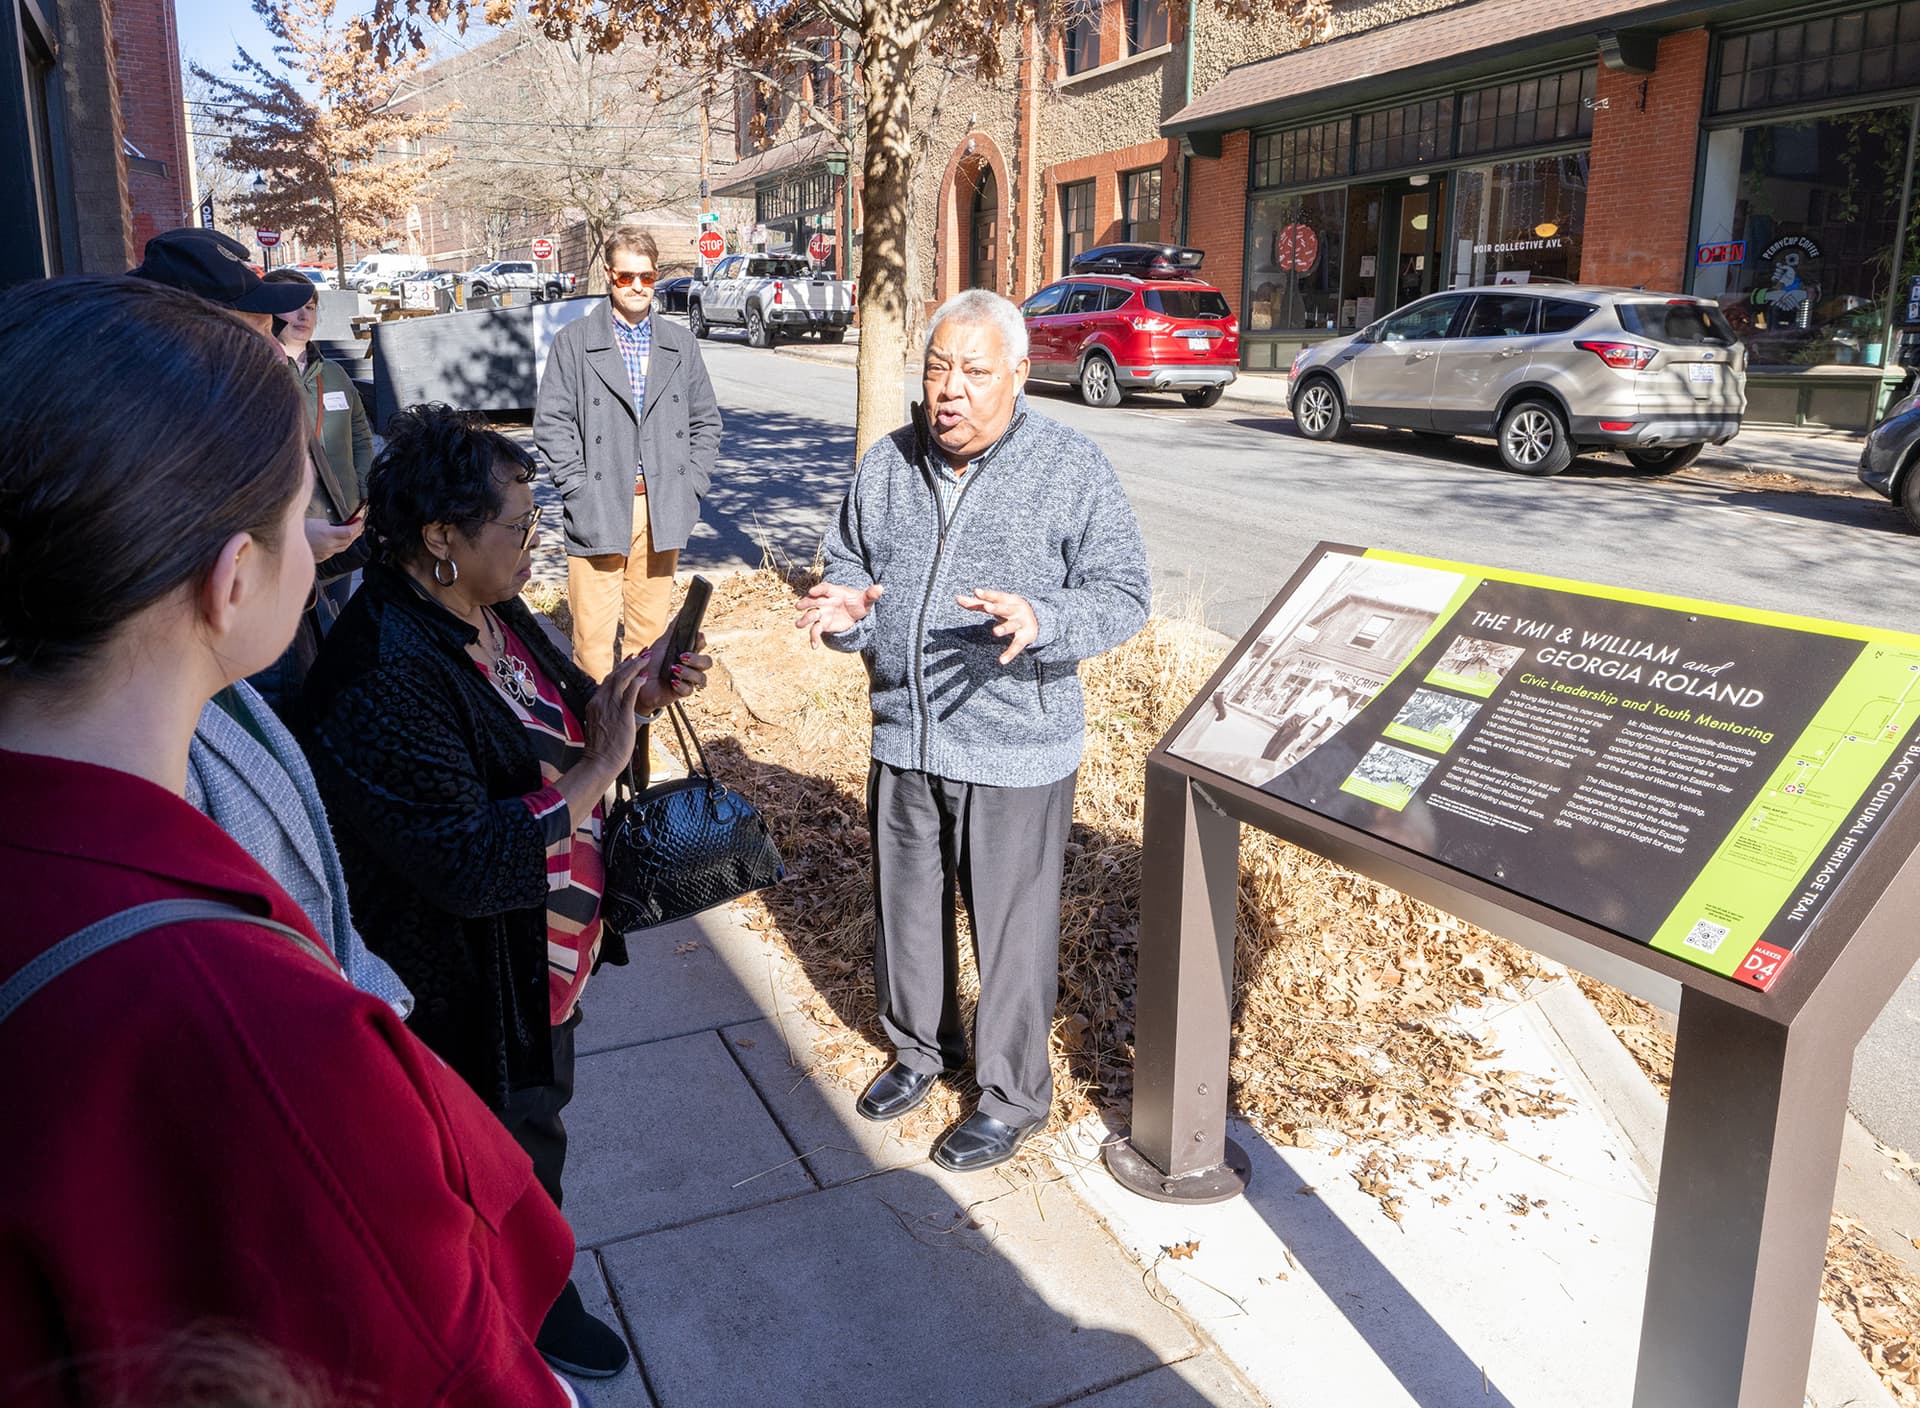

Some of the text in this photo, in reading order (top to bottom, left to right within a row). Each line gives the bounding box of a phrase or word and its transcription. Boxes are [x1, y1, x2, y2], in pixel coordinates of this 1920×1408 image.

[202, 205, 214, 230] OPE
[700, 239, 723, 251] STOP
[1473, 238, 1562, 254] NOIR COLLECTIVE AVL
[1697, 244, 1745, 264] OPEN
[1472, 610, 1735, 677] THE YMI & WILLIAM and
[1536, 647, 1764, 707] GEORGIA ROLAND
[1520, 673, 1774, 744] Civic Leadership and Youth Mentoring
[1621, 728, 1753, 767] County Citizens Organization, protecting
[1638, 722, 1663, 733] Roland
[1662, 728, 1674, 736] led
[1673, 731, 1685, 739] the
[1685, 734, 1757, 756] Asheville-Buncombe
[1615, 737, 1635, 747] voting
[1635, 742, 1654, 751] rights
[1654, 747, 1669, 755] and
[1667, 751, 1706, 766] advocating
[1717, 764, 1739, 773] equal
[1668, 760, 1694, 772] Roland
[1693, 768, 1708, 776] was
[1586, 775, 1598, 784] The
[1598, 779, 1625, 792] Rolands
[1624, 788, 1649, 799] offered
[1602, 754, 1629, 764] member
[1649, 765, 1669, 775] Order
[1676, 773, 1689, 781] the
[1689, 776, 1716, 789] Eastern
[1716, 784, 1733, 793] Star
[1620, 768, 1645, 779] League
[1653, 777, 1679, 789] Women
[1573, 792, 1690, 833] teenagers who founded the Asheville
[1591, 789, 1618, 801] meeting
[1617, 796, 1638, 806] space
[1646, 804, 1659, 812] the
[1658, 808, 1679, 819] Black
[1566, 801, 1592, 813] Student
[1591, 808, 1627, 824] Committee
[1636, 822, 1659, 834] Racial
[1658, 829, 1687, 844] Equality
[1787, 745, 1920, 920] BLACK CULTURAL HERITAGE TRAIL
[1616, 828, 1631, 836] and
[1629, 831, 1653, 844] fought
[1663, 843, 1685, 854] equal
[1744, 954, 1778, 977] D4
[1755, 946, 1782, 960] MARKER
